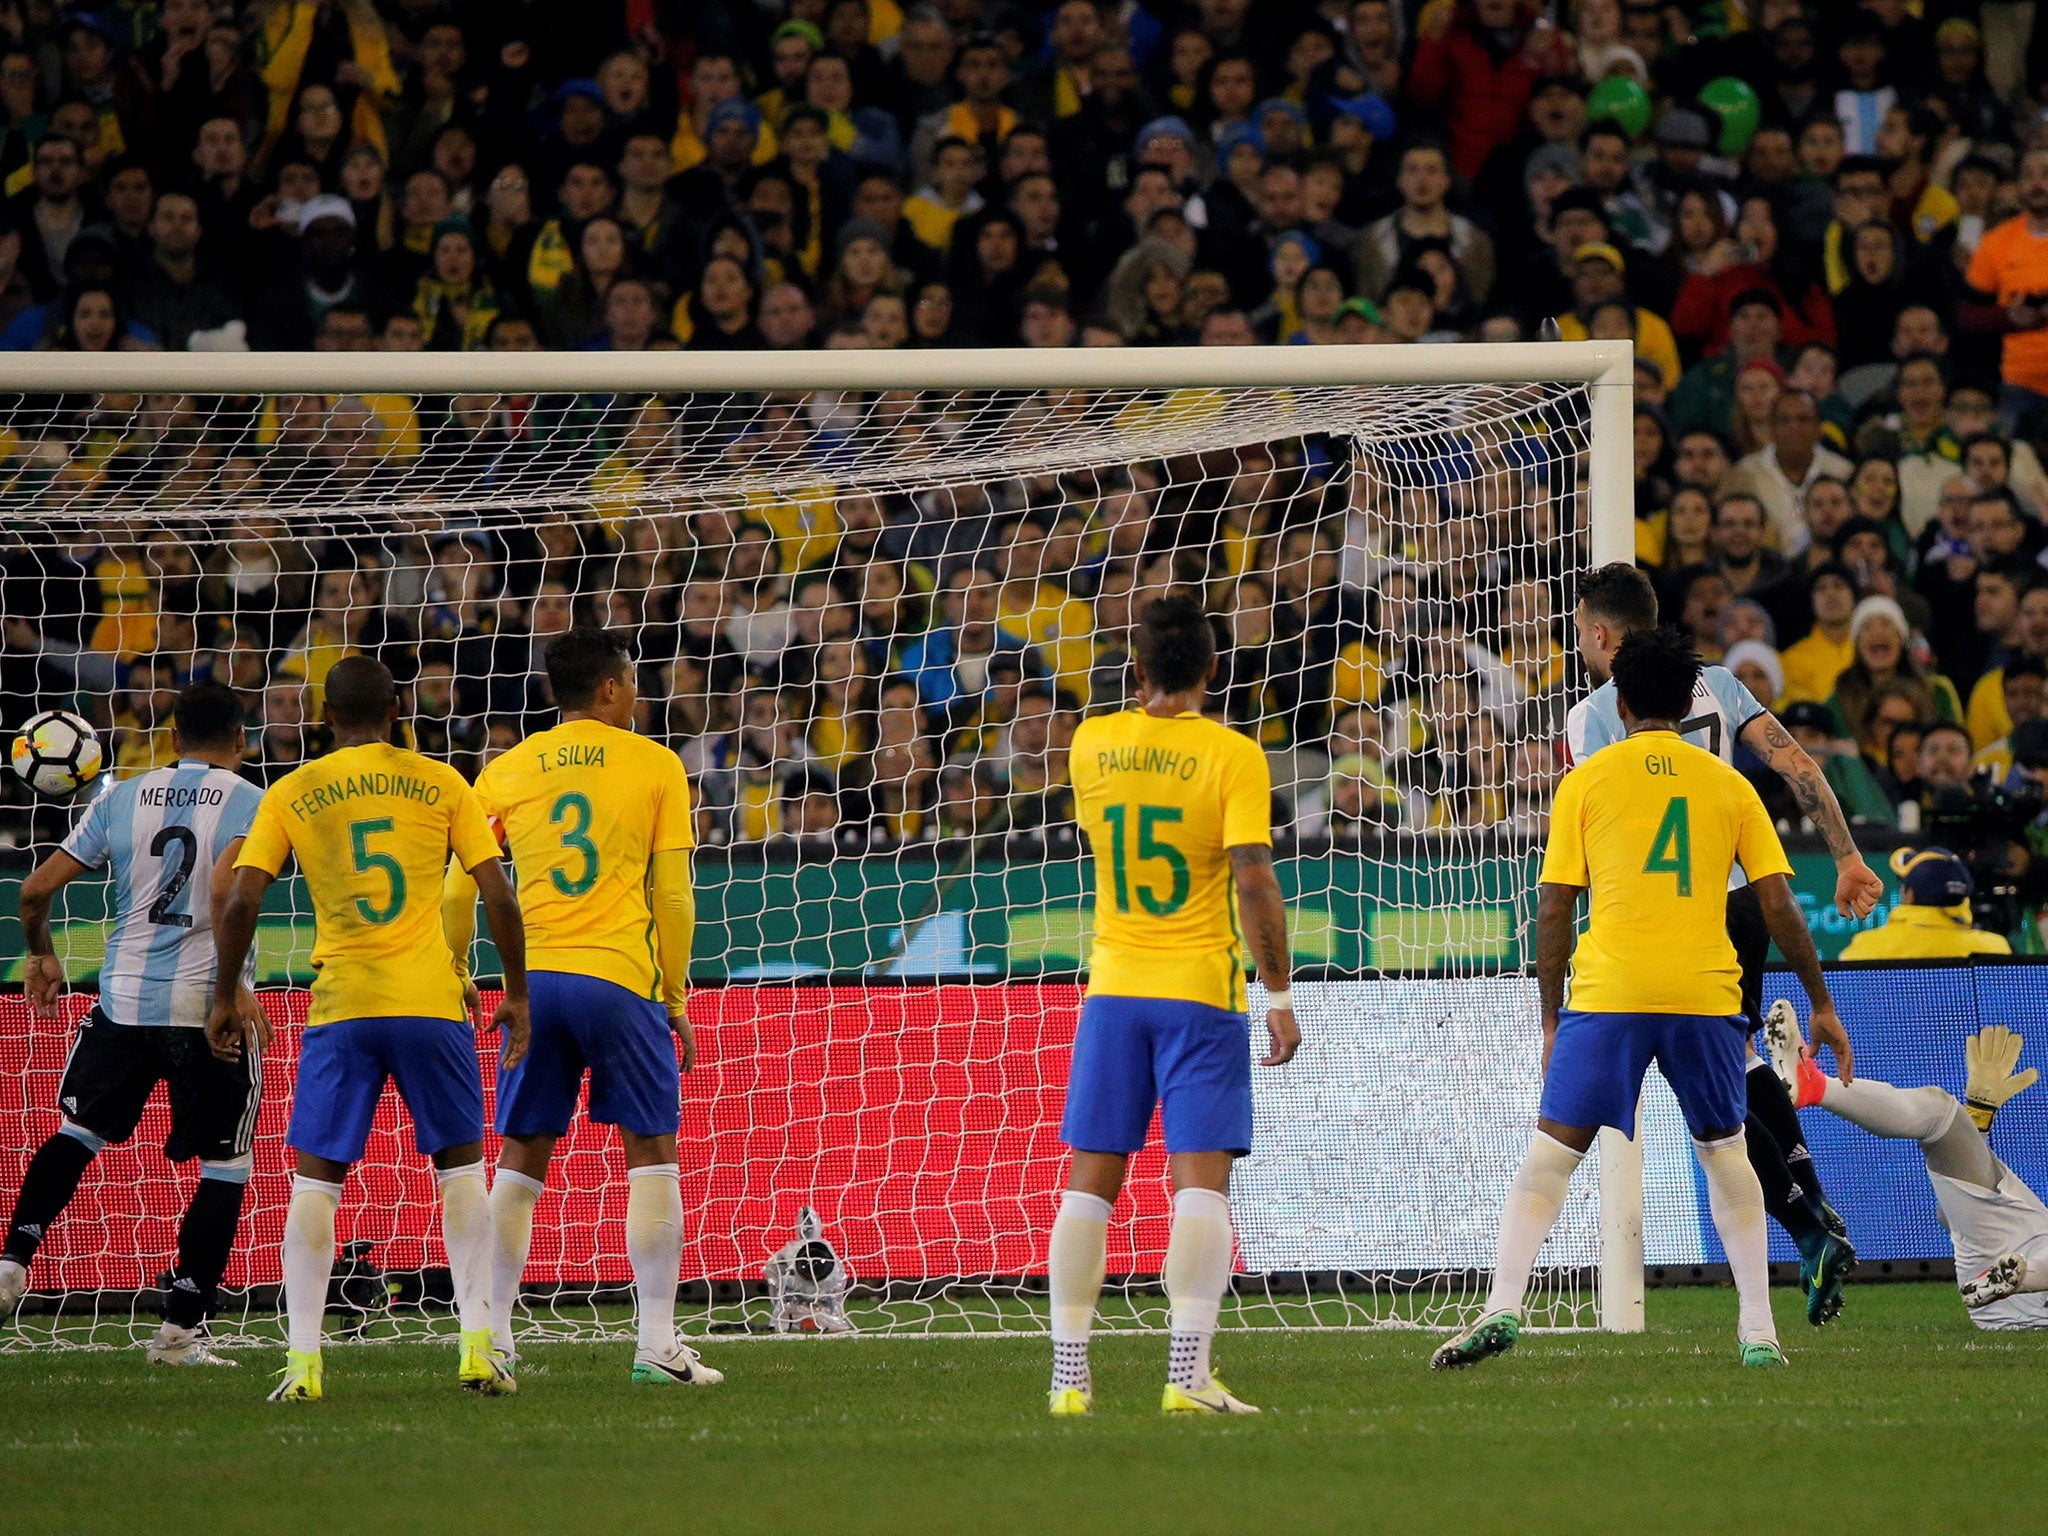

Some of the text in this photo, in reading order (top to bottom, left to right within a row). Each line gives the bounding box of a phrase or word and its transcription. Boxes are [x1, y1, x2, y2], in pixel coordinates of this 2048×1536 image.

[537, 745, 605, 772] T. SILVA
[1098, 747, 1198, 781] PAULINHO
[1645, 754, 1678, 776] GIL
[140, 787, 223, 807] MERCADO
[291, 773, 440, 822] FERNANDINHO
[149, 826, 197, 927] 2
[349, 816, 407, 925] 5
[549, 791, 600, 897] 3
[1103, 803, 1190, 917] 15
[1642, 797, 1692, 897] 4
